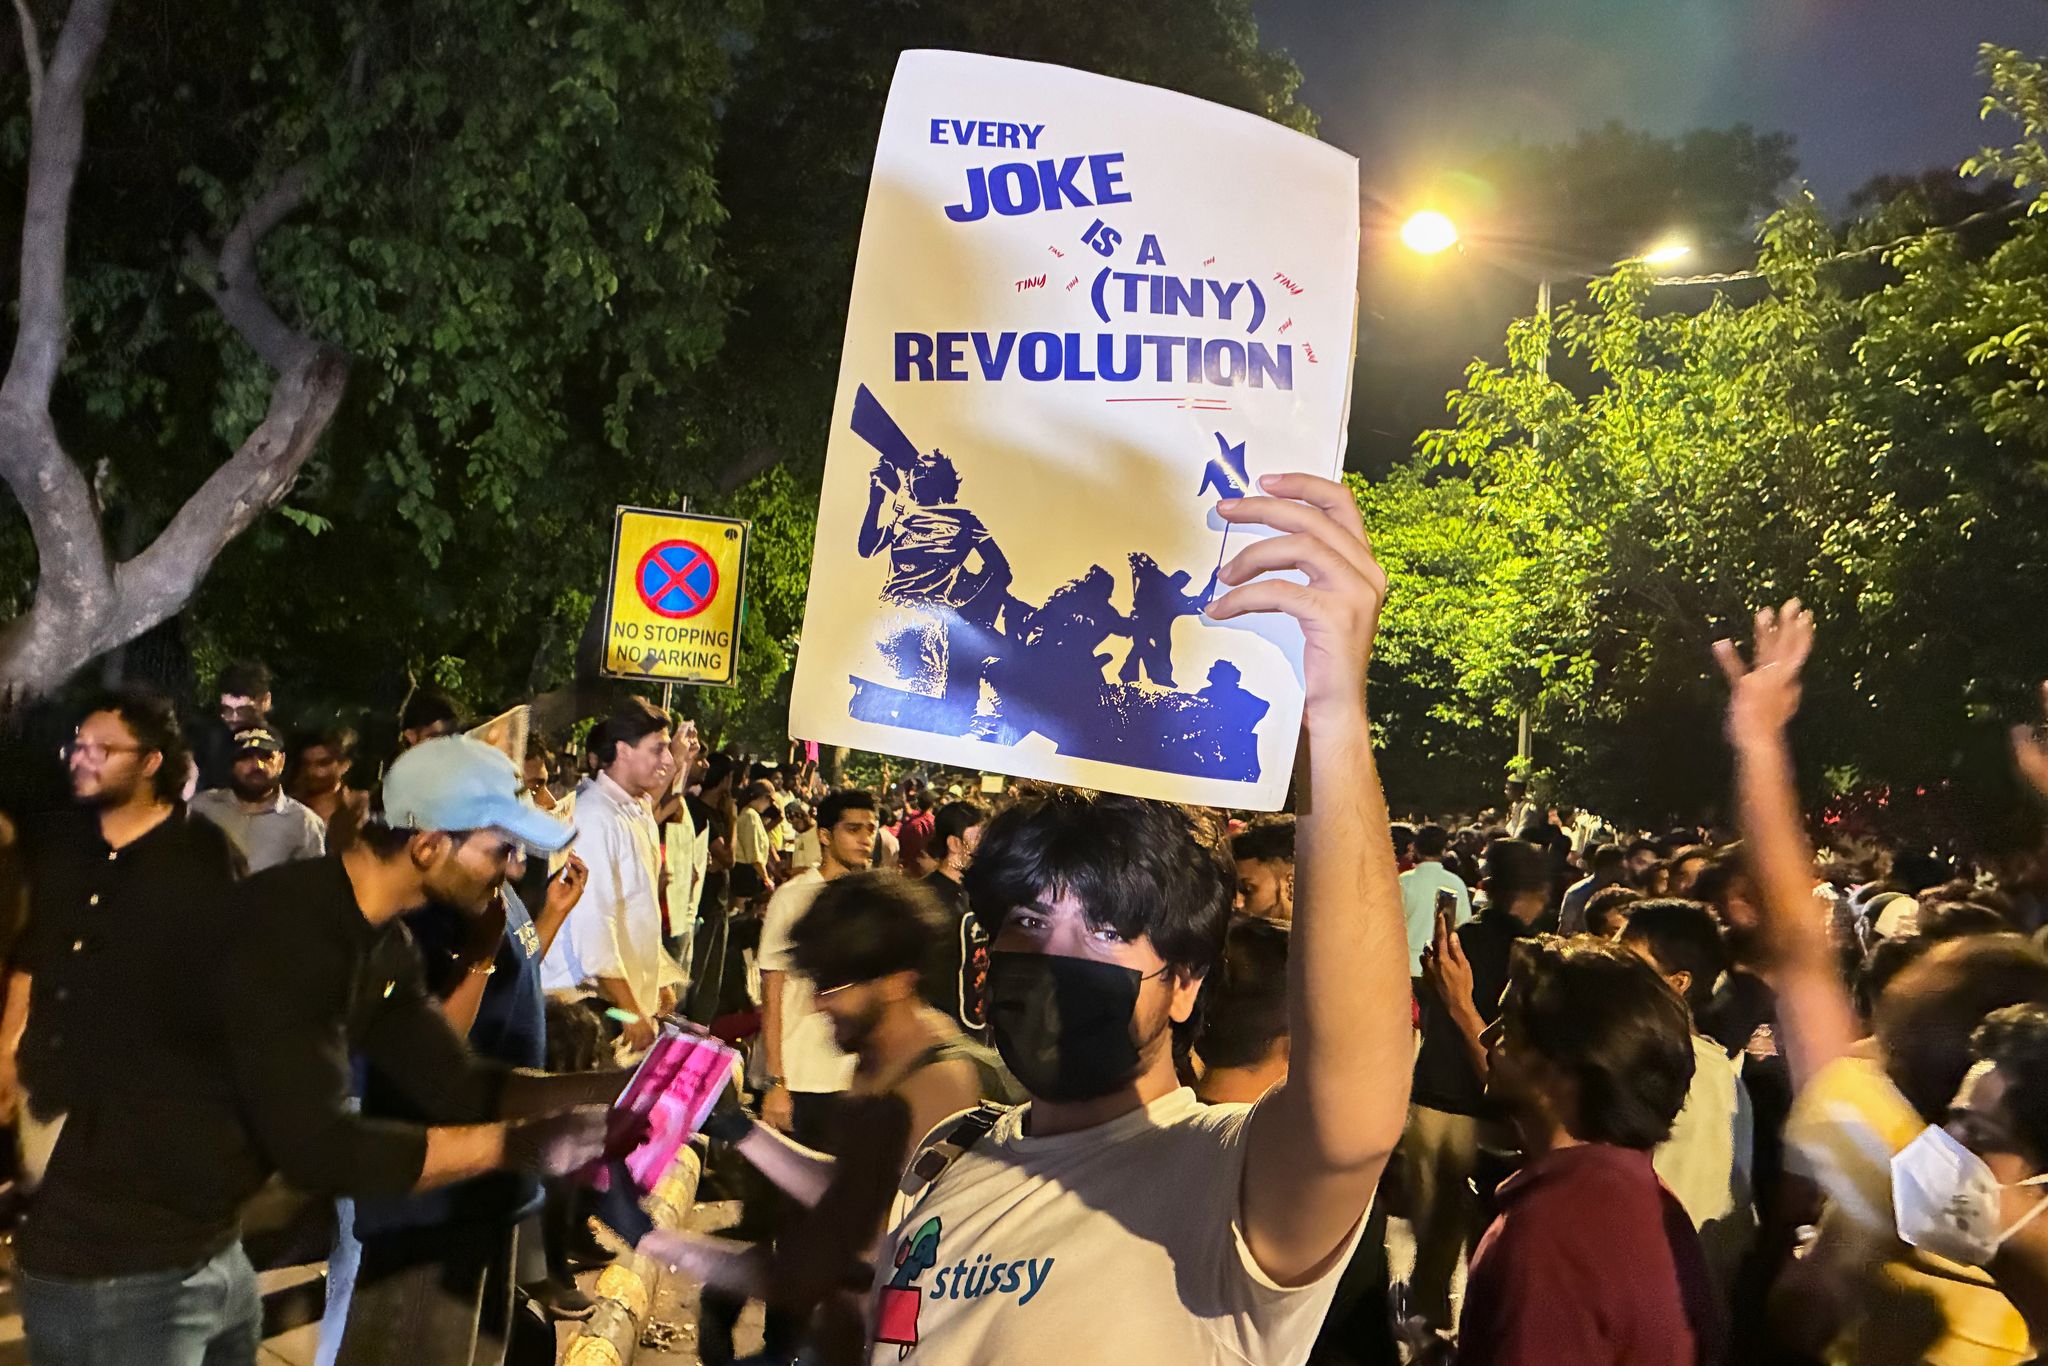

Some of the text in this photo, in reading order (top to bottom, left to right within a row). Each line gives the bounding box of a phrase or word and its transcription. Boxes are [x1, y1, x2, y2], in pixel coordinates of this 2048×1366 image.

[929, 118, 1045, 150] EVERY
[944, 152, 1132, 223] JOKE
[1081, 218, 1166, 266] IS A
[1014, 273, 1047, 293] TINY
[1065, 275, 1079, 292] TINY
[1272, 271, 1304, 296] TINY
[1090, 266, 1266, 334] (TINY)
[894, 331, 1293, 391] REVOLUTION
[613, 621, 729, 648] NO STOPPING
[615, 645, 641, 663] NO
[929, 1253, 1055, 1307] stüssy
